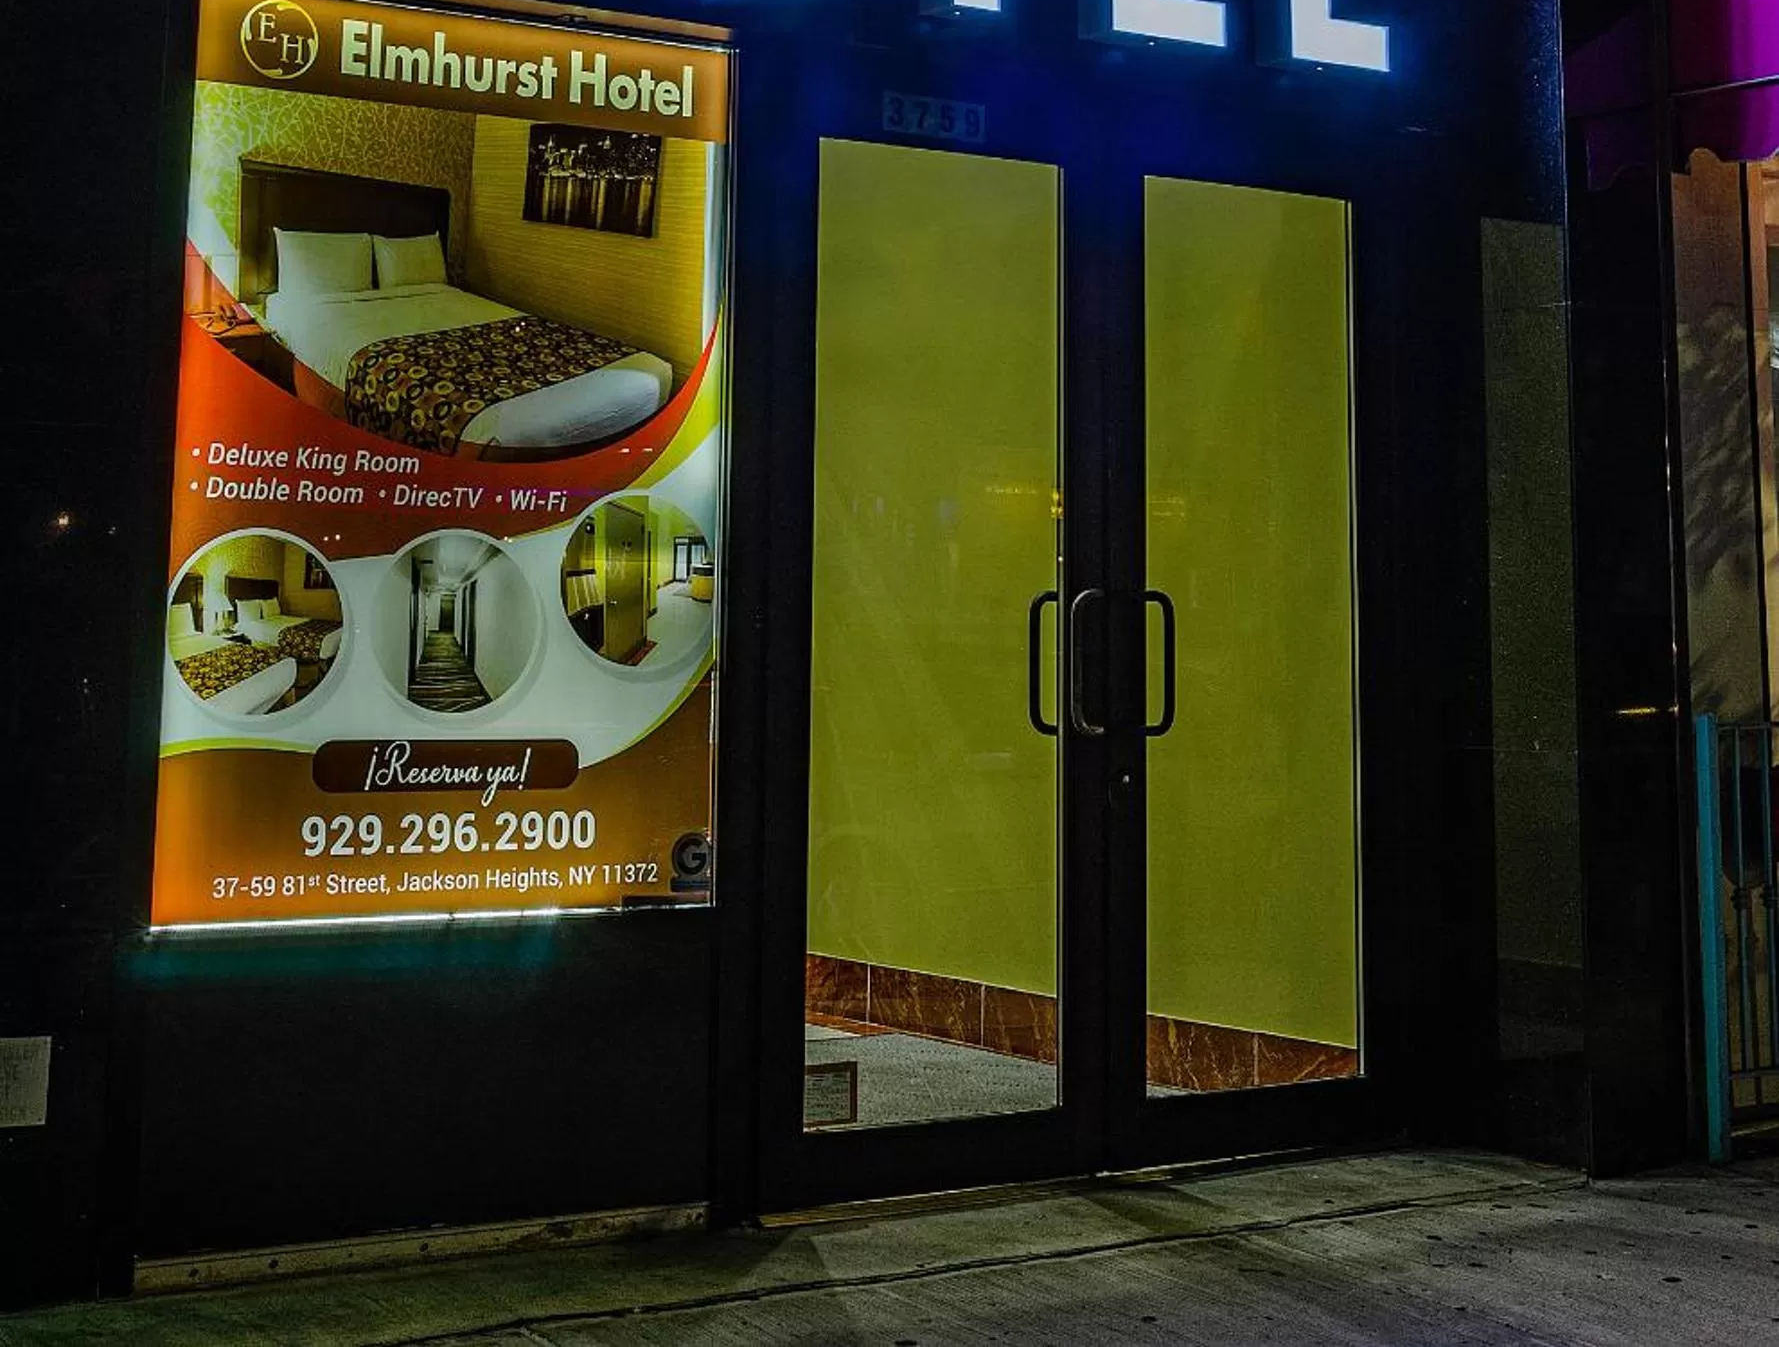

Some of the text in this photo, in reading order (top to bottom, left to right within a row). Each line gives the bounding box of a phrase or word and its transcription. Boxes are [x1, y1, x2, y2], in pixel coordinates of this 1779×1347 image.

[258, 12, 306, 65] EH
[340, 18, 694, 117] Elmhurst Hotel
[888, 95, 981, 138] 3759
[207, 442, 420, 476] Deluxe King Room
[206, 476, 567, 513] Double Room DirecTV Wi-Fi
[364, 741, 522, 808] ¡Reserva ya!
[300, 809, 596, 857] 929.296.2900
[212, 876, 276, 899] 37-59
[281, 874, 320, 896] 81st
[326, 873, 391, 895] Street,
[396, 869, 479, 892] Jackson
[486, 866, 564, 893] Heights,
[569, 865, 597, 885] NY
[602, 863, 659, 885] 11372
